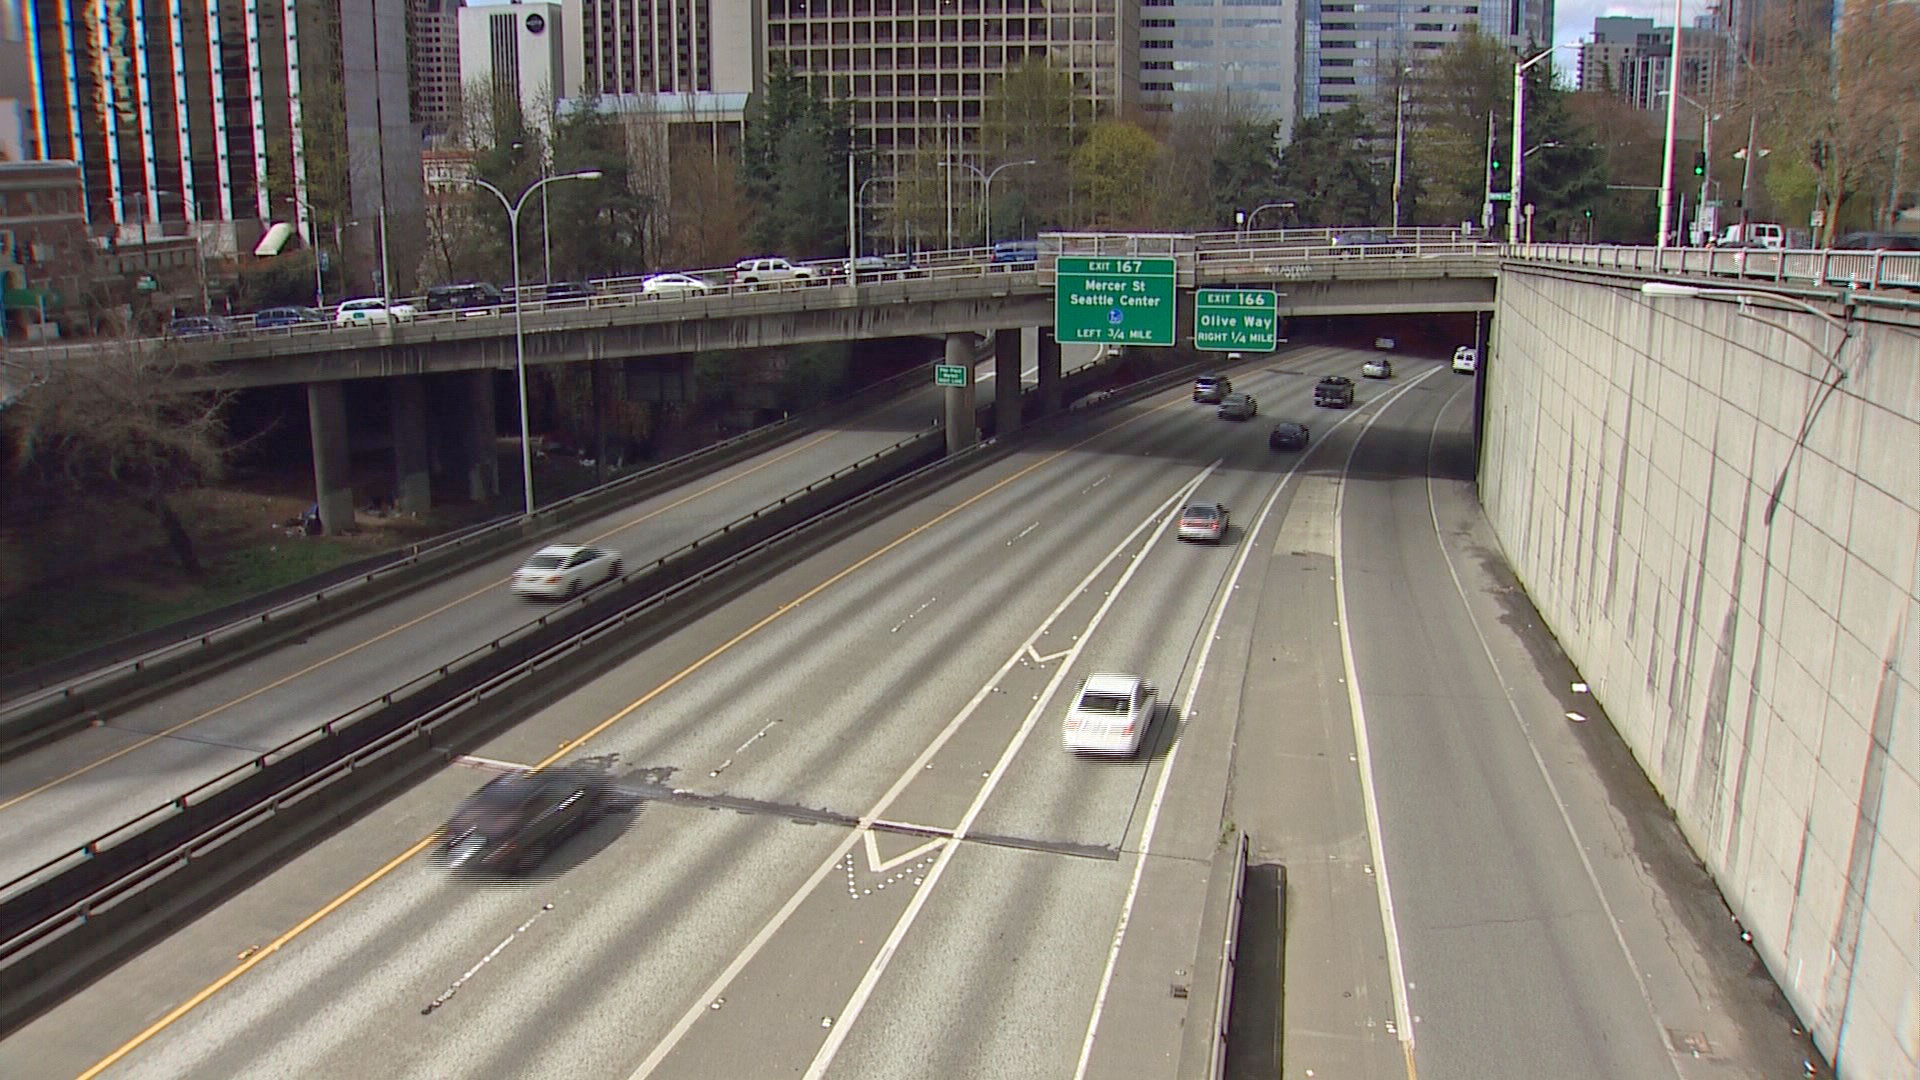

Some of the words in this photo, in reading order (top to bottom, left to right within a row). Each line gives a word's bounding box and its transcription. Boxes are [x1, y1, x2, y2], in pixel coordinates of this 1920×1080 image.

[1088, 261, 1110, 271] EXIT
[1116, 260, 1143, 273] 167
[1085, 279, 1127, 291] Mercer
[1132, 280, 1146, 292] St
[1070, 294, 1114, 305] Seattle
[1119, 295, 1161, 306] Center
[1207, 293, 1232, 304] EXIT
[1238, 293, 1265, 305] 166
[1201, 315, 1237, 327] Olive
[1243, 315, 1272, 330] Way
[1076, 328, 1102, 338] LEFT
[1129, 330, 1153, 339] MILE
[1198, 332, 1228, 342] RIGHT
[1249, 333, 1274, 343] MILE
